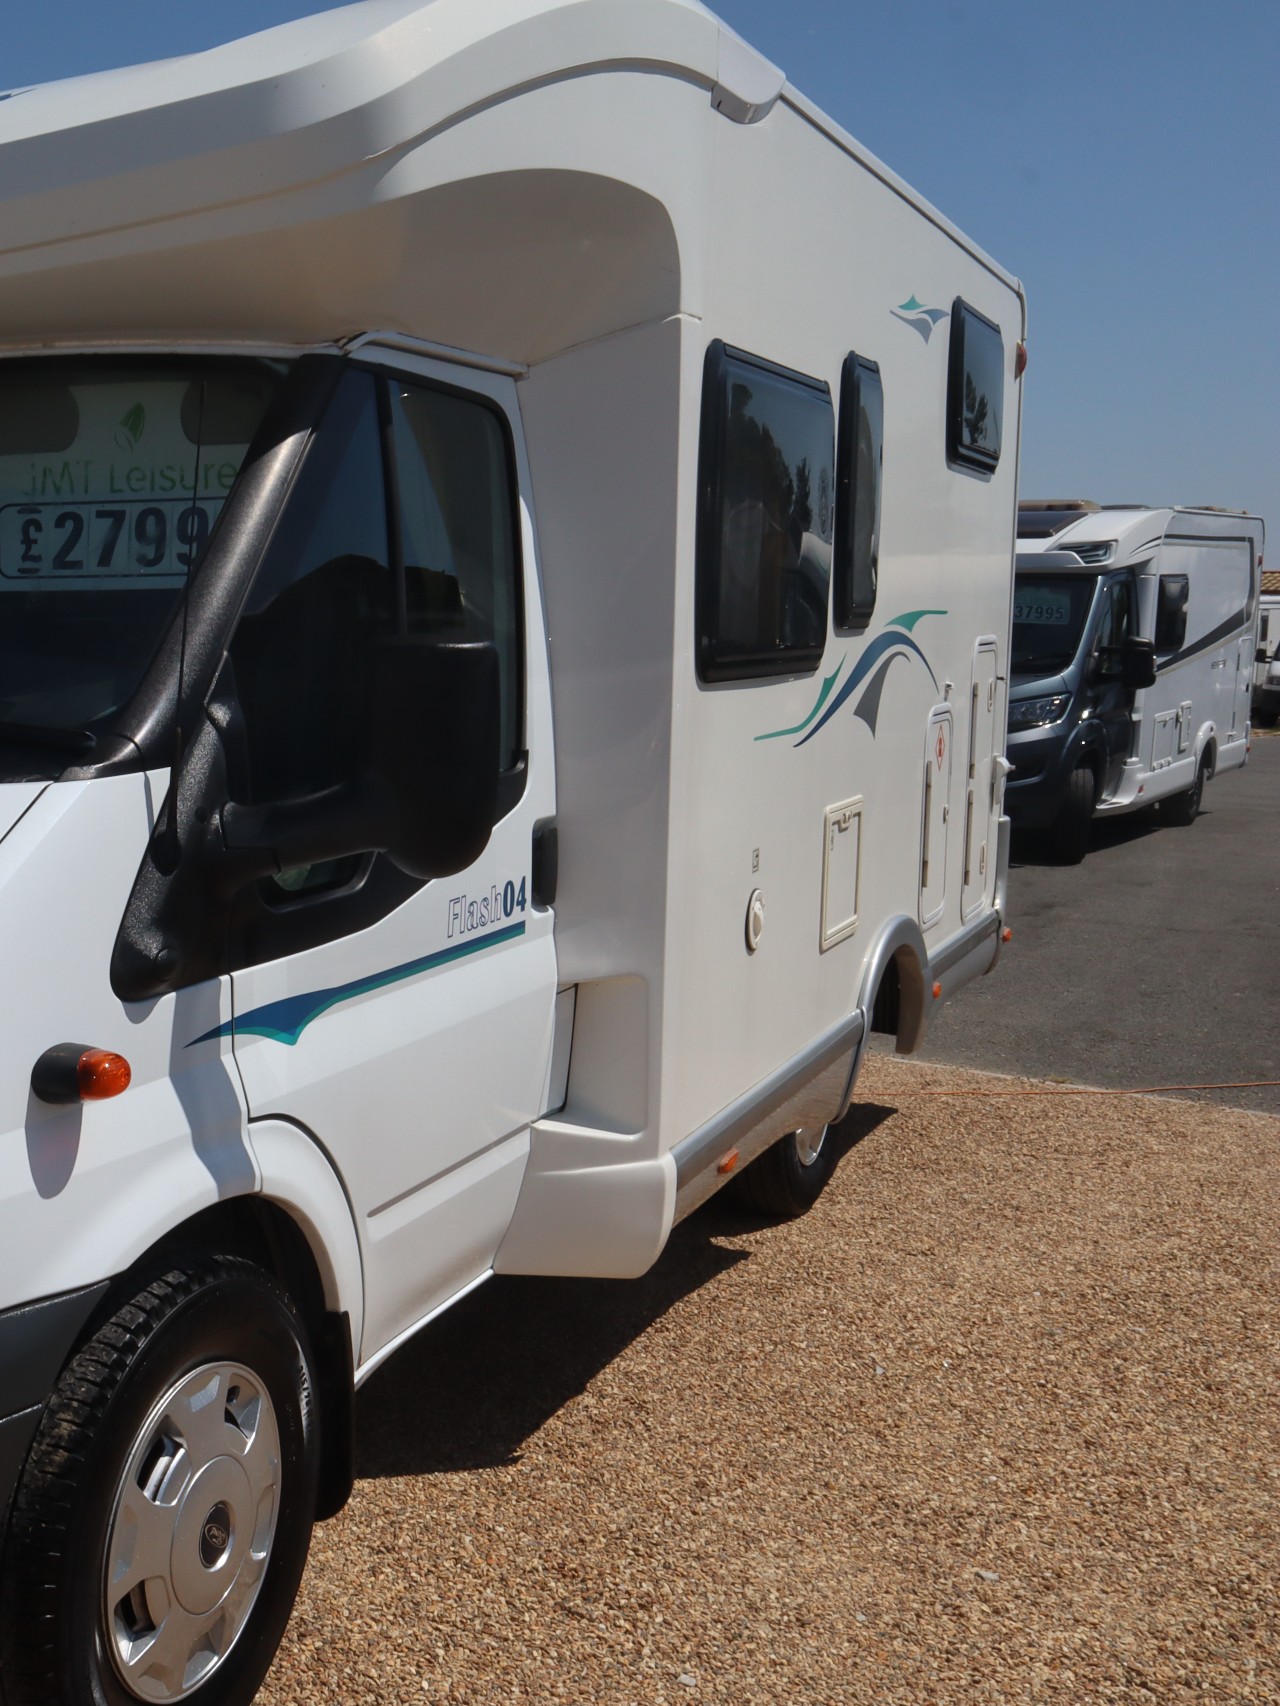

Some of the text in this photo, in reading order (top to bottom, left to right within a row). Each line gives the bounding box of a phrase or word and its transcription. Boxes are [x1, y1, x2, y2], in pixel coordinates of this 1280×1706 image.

[109, 460, 239, 493] Leisure
[16, 505, 210, 575] £2799
[1014, 605, 1065, 620] 37995
